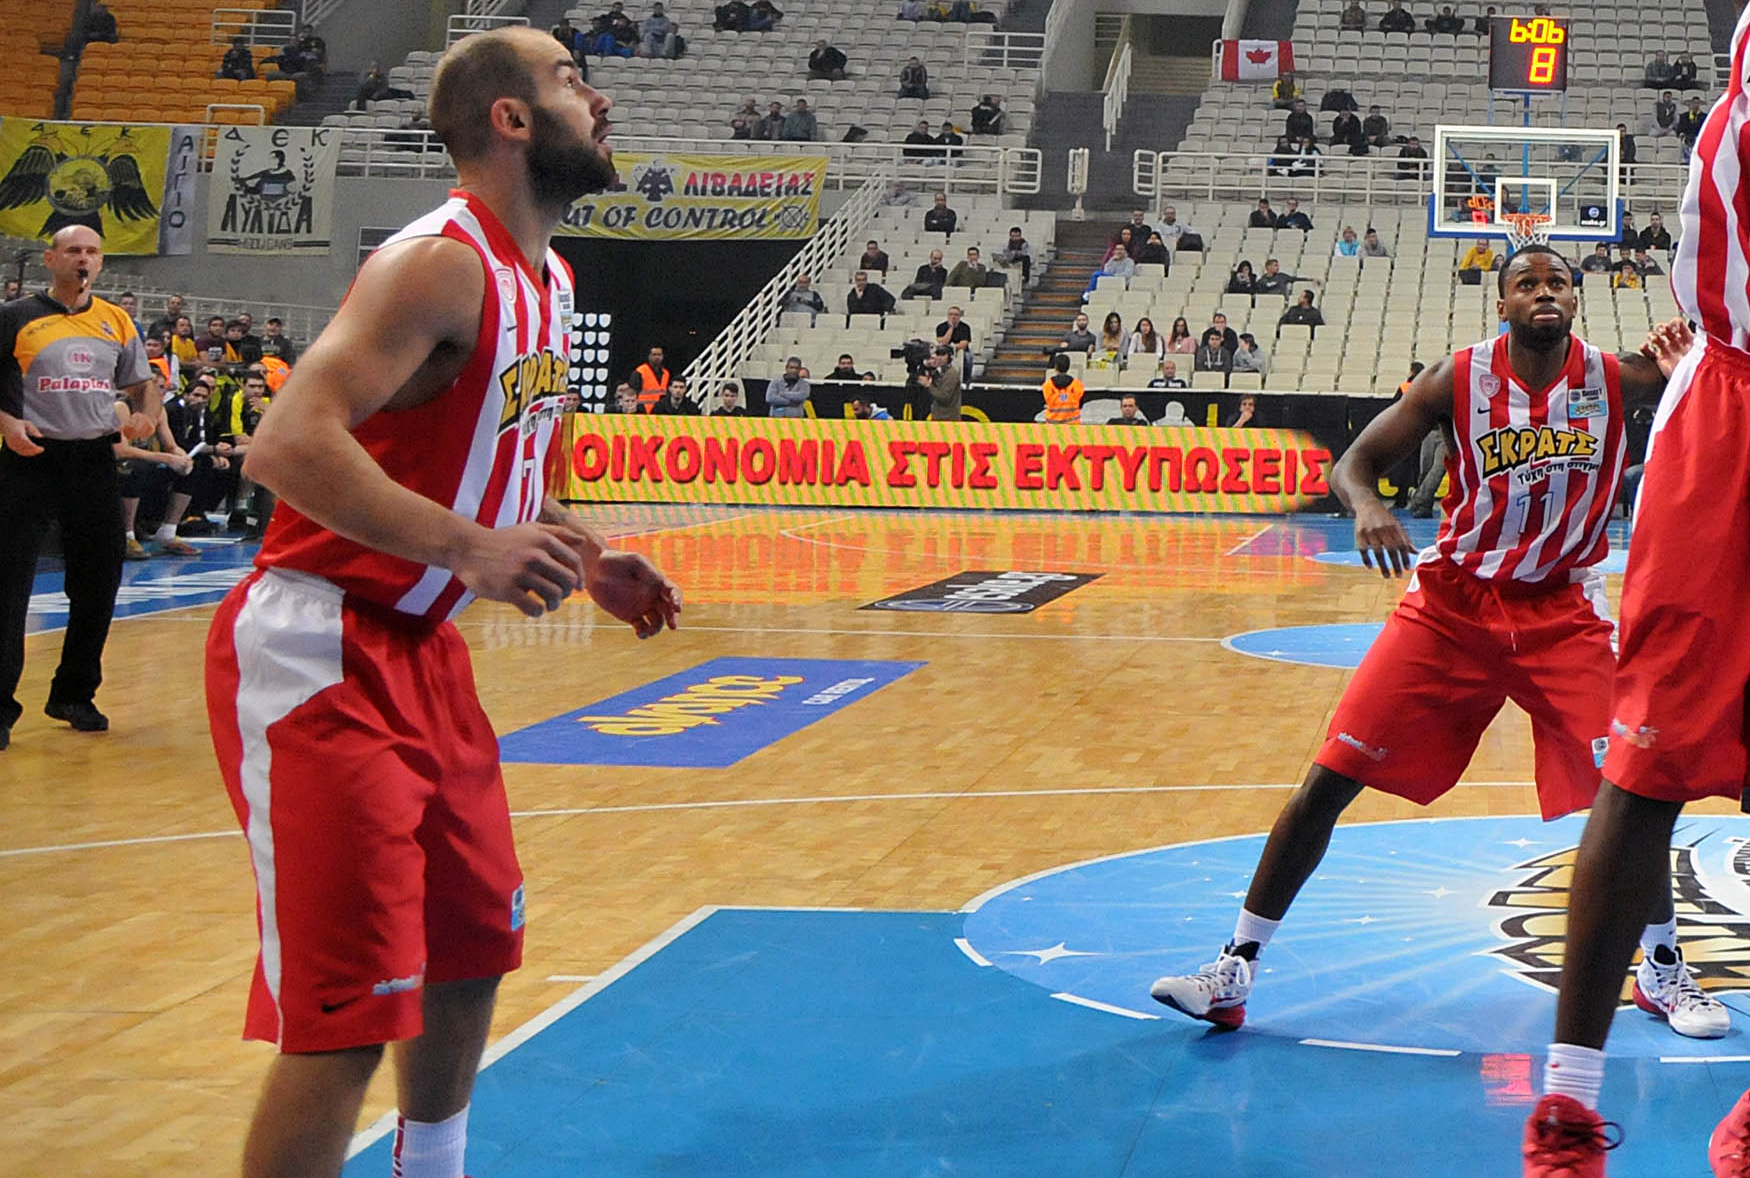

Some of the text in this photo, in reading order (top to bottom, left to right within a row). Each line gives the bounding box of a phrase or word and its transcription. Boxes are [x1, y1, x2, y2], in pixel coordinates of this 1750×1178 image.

[1528, 46, 1558, 84] 8
[603, 205, 637, 228] OF
[646, 207, 769, 229] CONTROL
[573, 433, 1332, 496] ΟΙΚΟΝΟΜΙΑ ΣΤΙΣ ΕΚΤΥΠΩΣΕΙΣ
[1476, 427, 1599, 479] ΣΚΡΑΤΣ
[1516, 491, 1554, 534] 11
